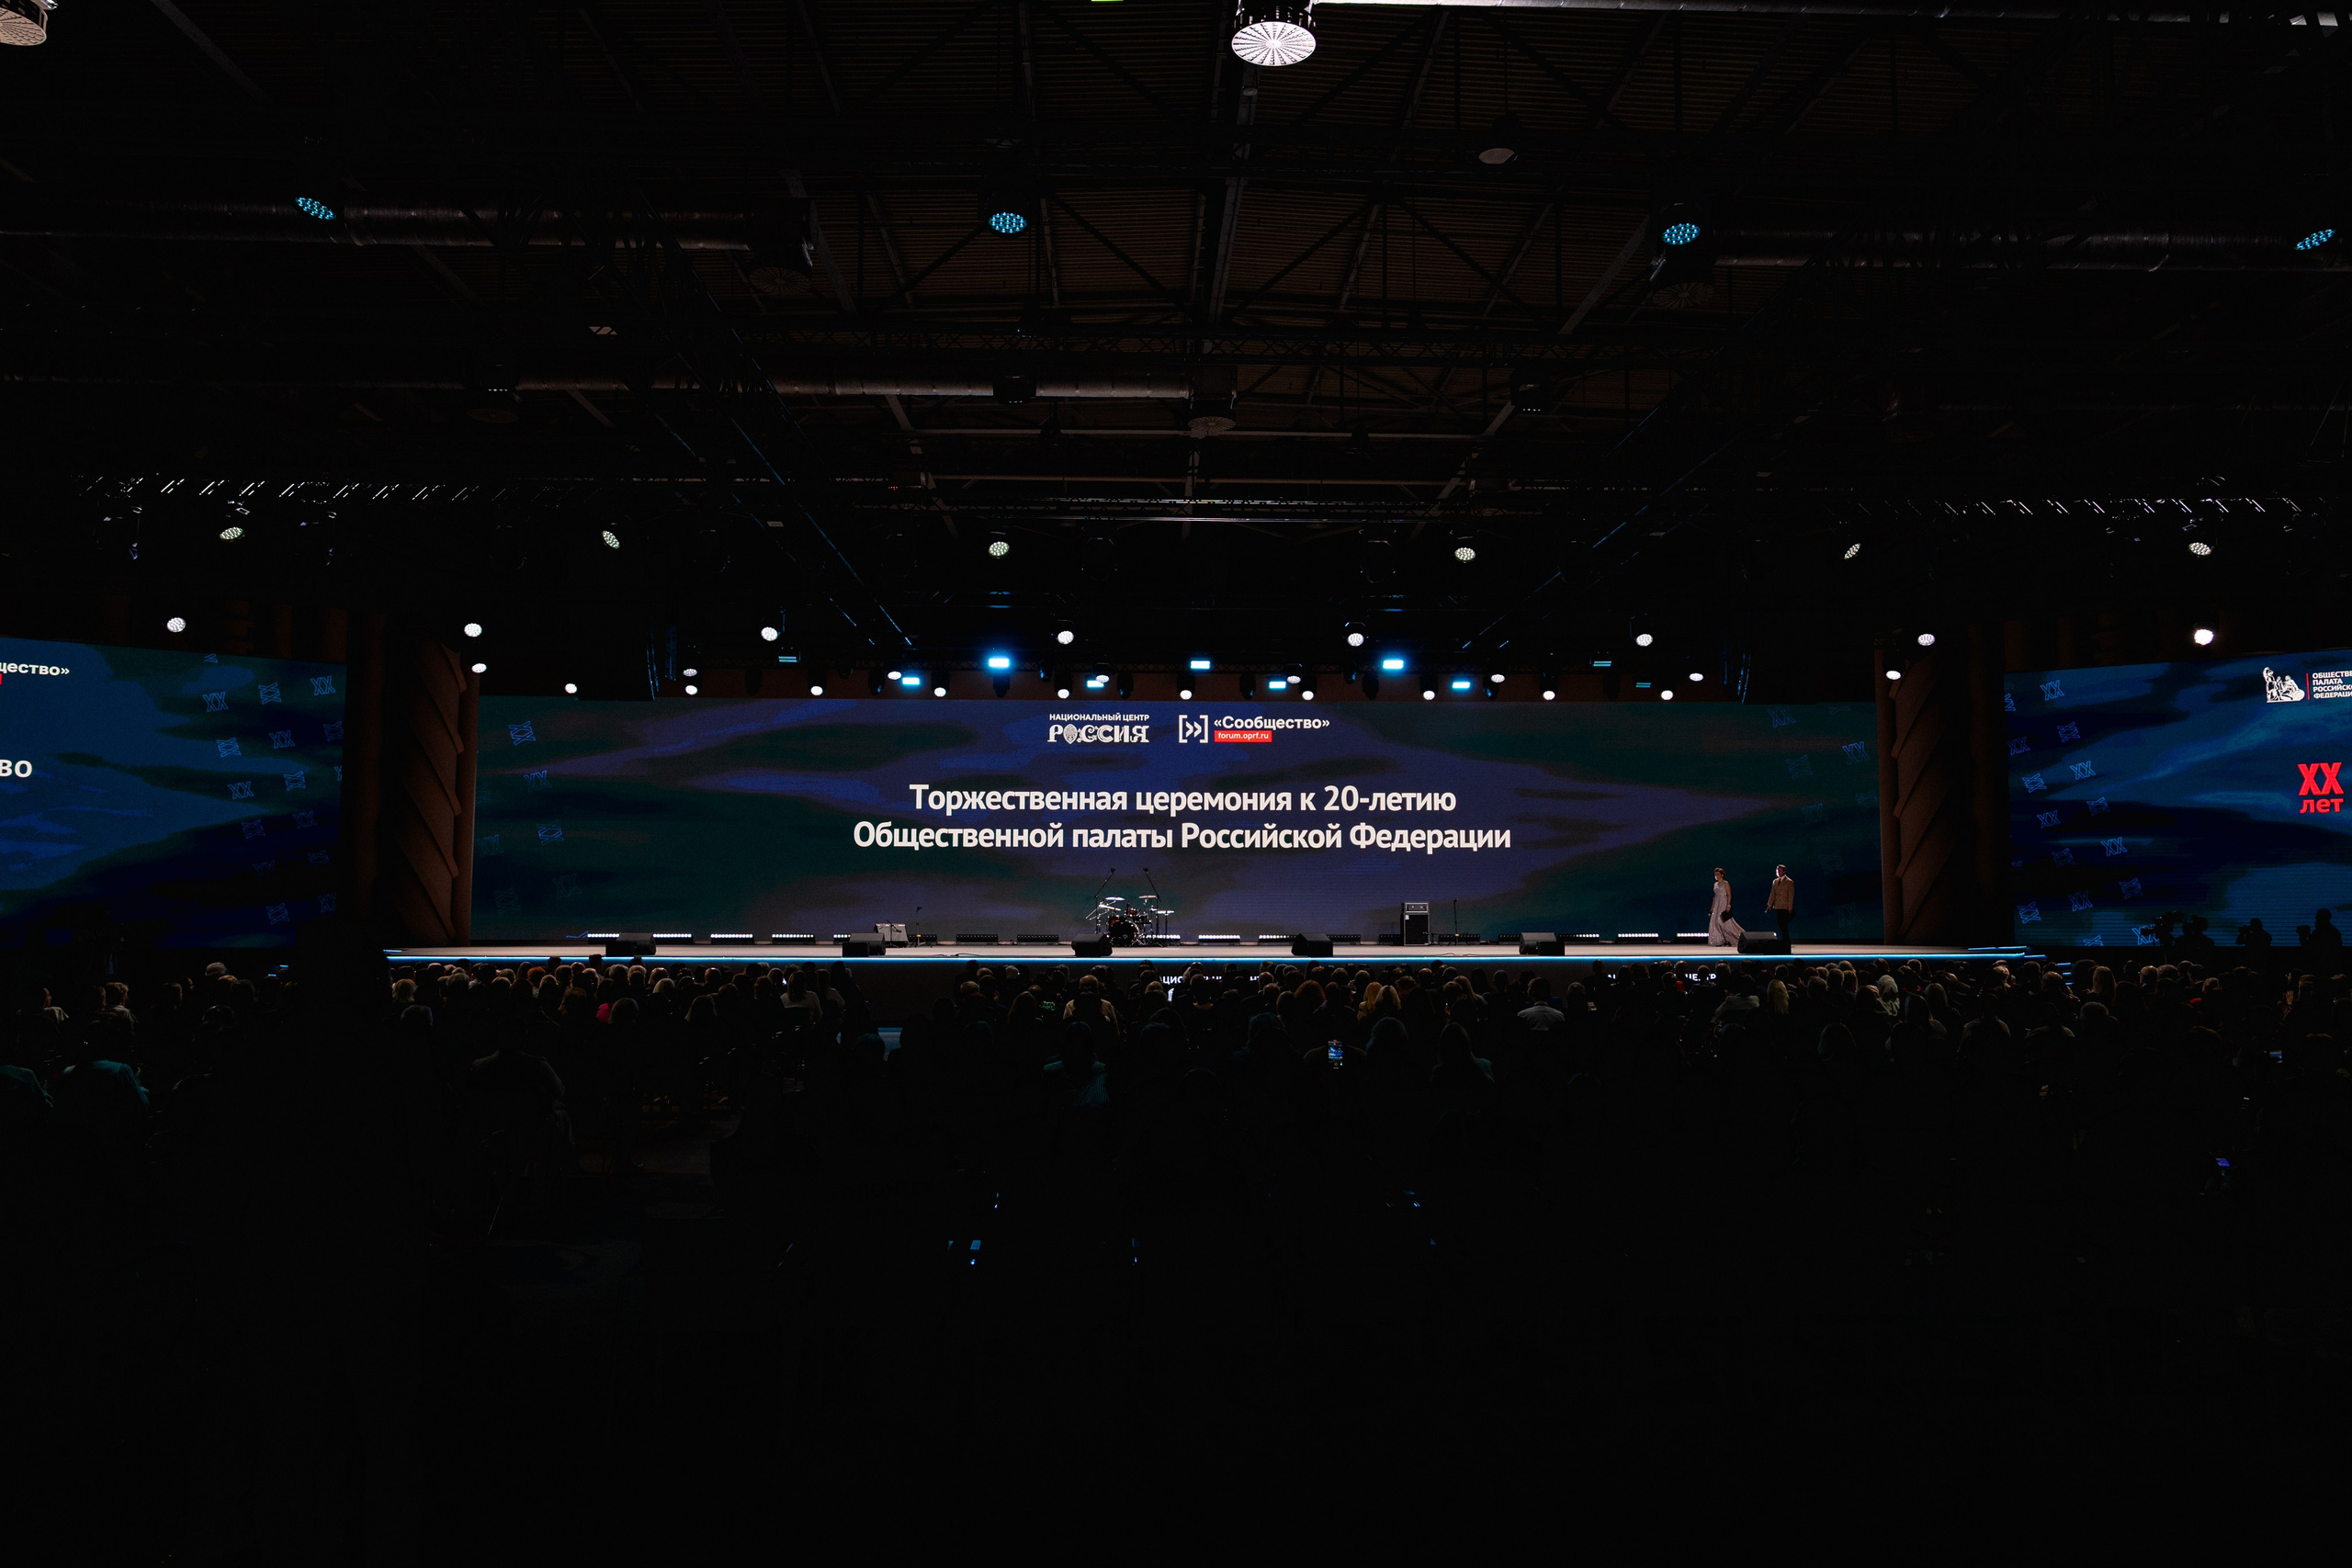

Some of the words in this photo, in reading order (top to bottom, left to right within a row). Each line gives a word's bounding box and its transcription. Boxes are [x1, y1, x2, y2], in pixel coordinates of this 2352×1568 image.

[2312, 678, 2343, 686] ПАЛАТА
[1049, 713, 1121, 722] НАЦИОНАЛЬНЫЙ
[1123, 715, 1149, 723] ЦЕНТР
[1214, 716, 1330, 731] «Сообщество»
[1047, 724, 1149, 745] РОССИЯ
[1217, 732, 1270, 740] forum.oprf.ru
[910, 784, 1128, 817] Торжественная
[1136, 792, 1292, 817] церемония
[1301, 793, 1317, 811] к
[1324, 784, 1457, 812] 20-летию
[2300, 797, 2345, 815] лет
[854, 821, 1064, 852] Общественной
[1073, 829, 1177, 849] палаты
[1182, 821, 1342, 849] Российской
[1350, 821, 1511, 855] Федерации
